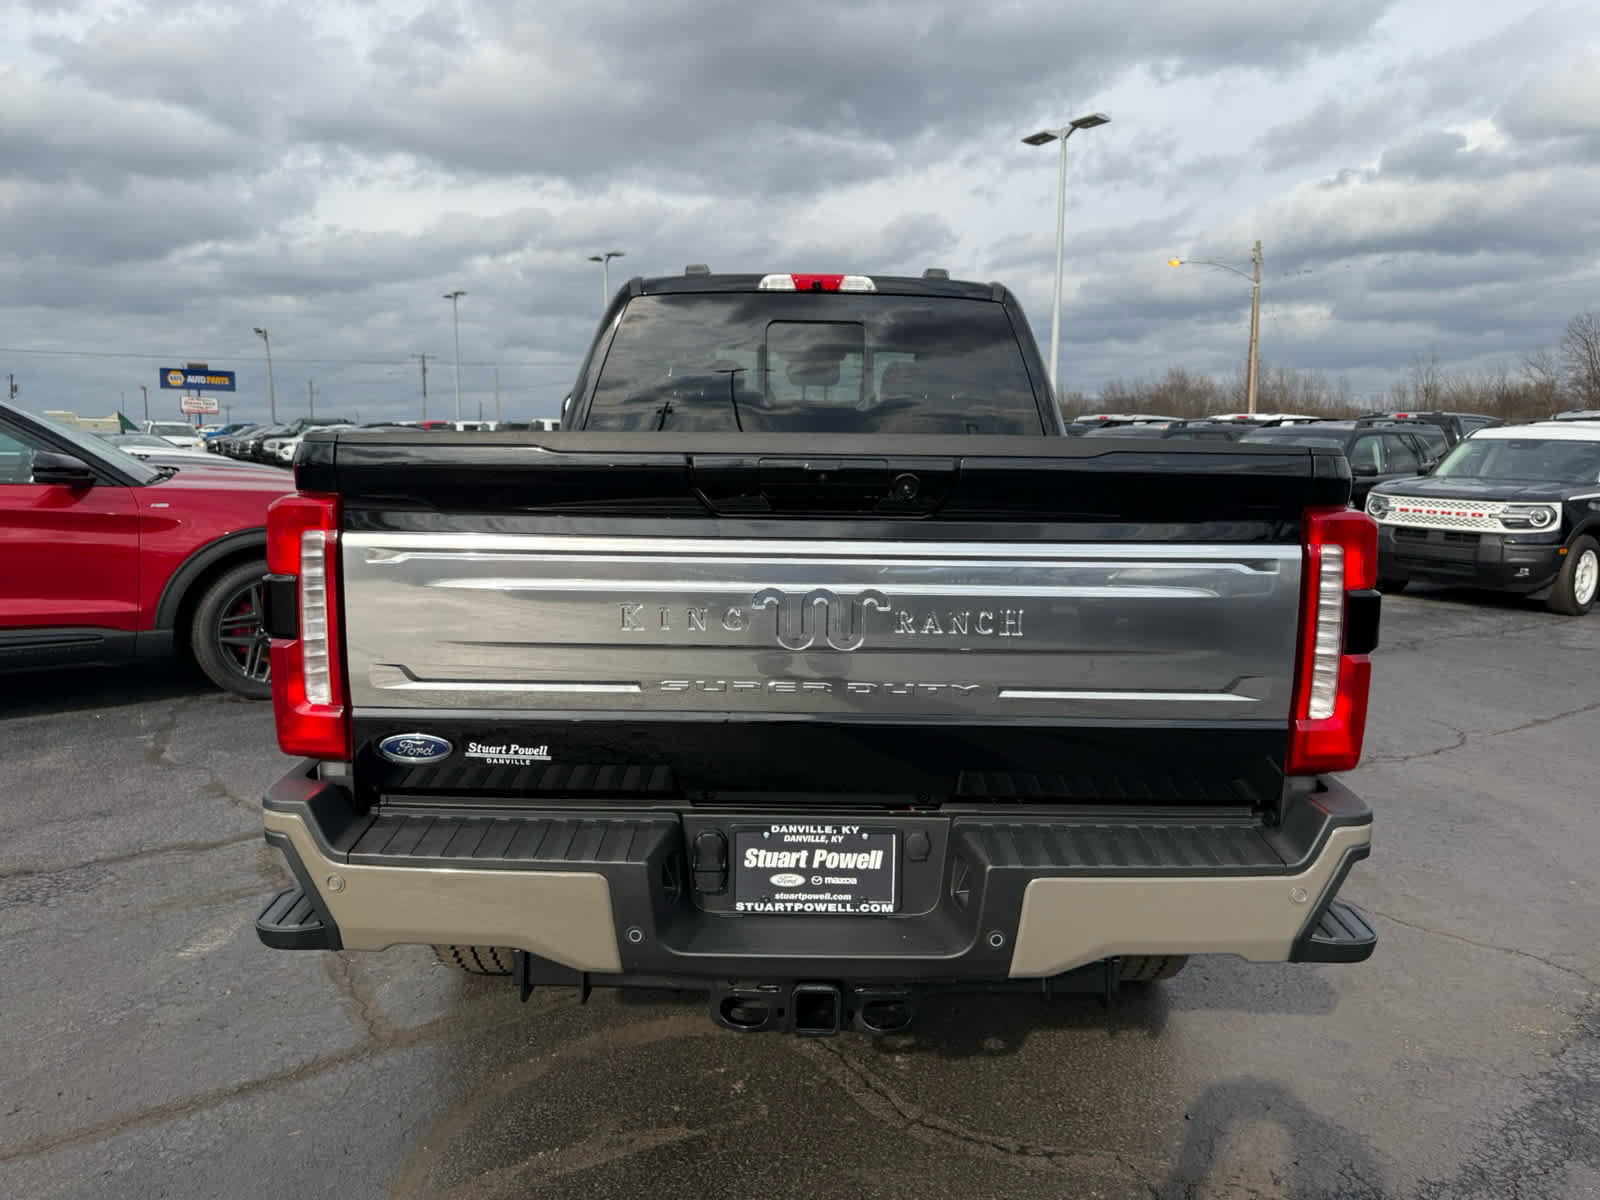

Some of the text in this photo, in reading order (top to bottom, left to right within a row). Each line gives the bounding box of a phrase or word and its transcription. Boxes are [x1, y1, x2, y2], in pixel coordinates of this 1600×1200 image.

[186, 375, 206, 384] AUTO
[1399, 507, 1483, 518] BRONCO
[619, 602, 1025, 637] KING RANCH
[659, 680, 980, 695] SUPER DUTY
[397, 739, 434, 757] Ford
[468, 742, 548, 756] Stuart Powell
[486, 757, 531, 766] DANVILLE
[771, 825, 860, 834] DANVILLE, KY
[783, 835, 829, 844] DANVILLE,
[744, 848, 884, 870] Stuart Powell
[774, 892, 852, 901] stuartpowell.com
[735, 902, 894, 913] STUARTPOWELL.COM
